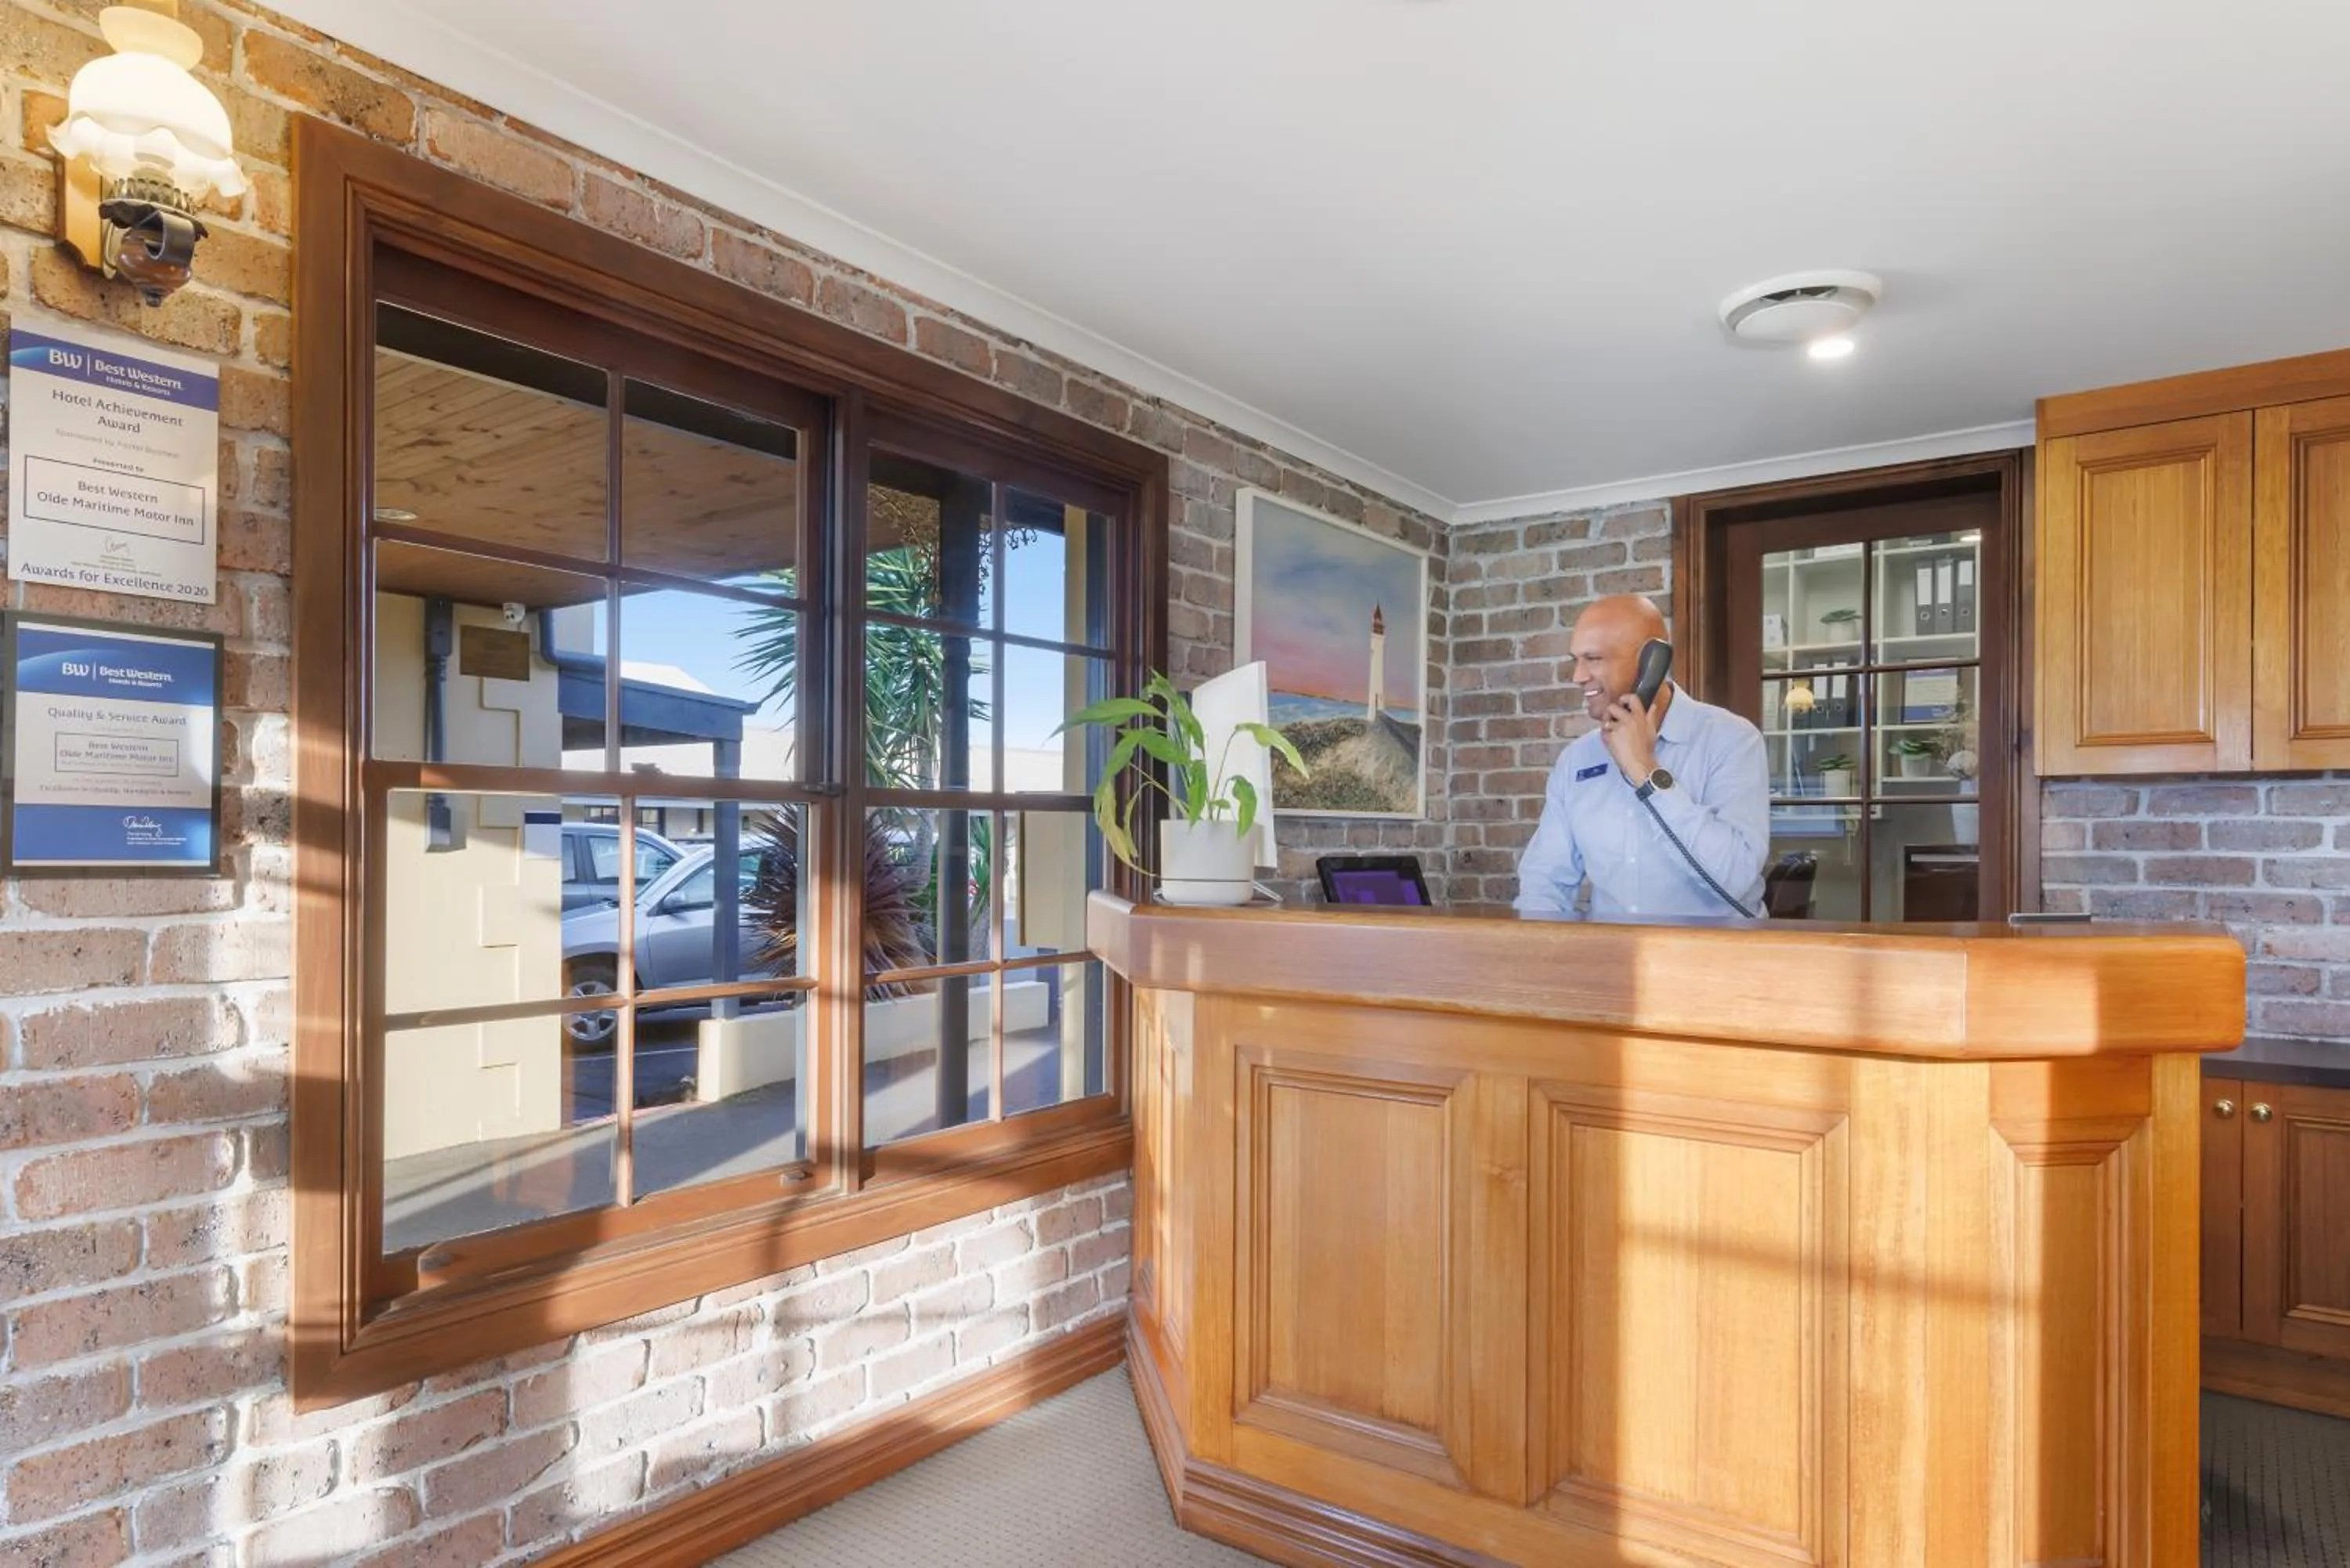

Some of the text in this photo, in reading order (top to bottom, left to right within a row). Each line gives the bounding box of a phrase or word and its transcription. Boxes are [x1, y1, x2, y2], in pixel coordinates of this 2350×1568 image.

[49, 349, 182, 390] BW Best Western
[52, 389, 183, 427] Hotel Achievement
[98, 416, 141, 433] Award
[78, 480, 158, 504] Best Western
[37, 491, 194, 526] Olde Maritime Motor Inn
[21, 562, 74, 580] Awards
[79, 569, 99, 583] for
[104, 573, 173, 594] Excellence
[177, 584, 209, 598] 2020
[62, 662, 172, 682] BW Best Western
[48, 706, 186, 726] Quality & Service Award
